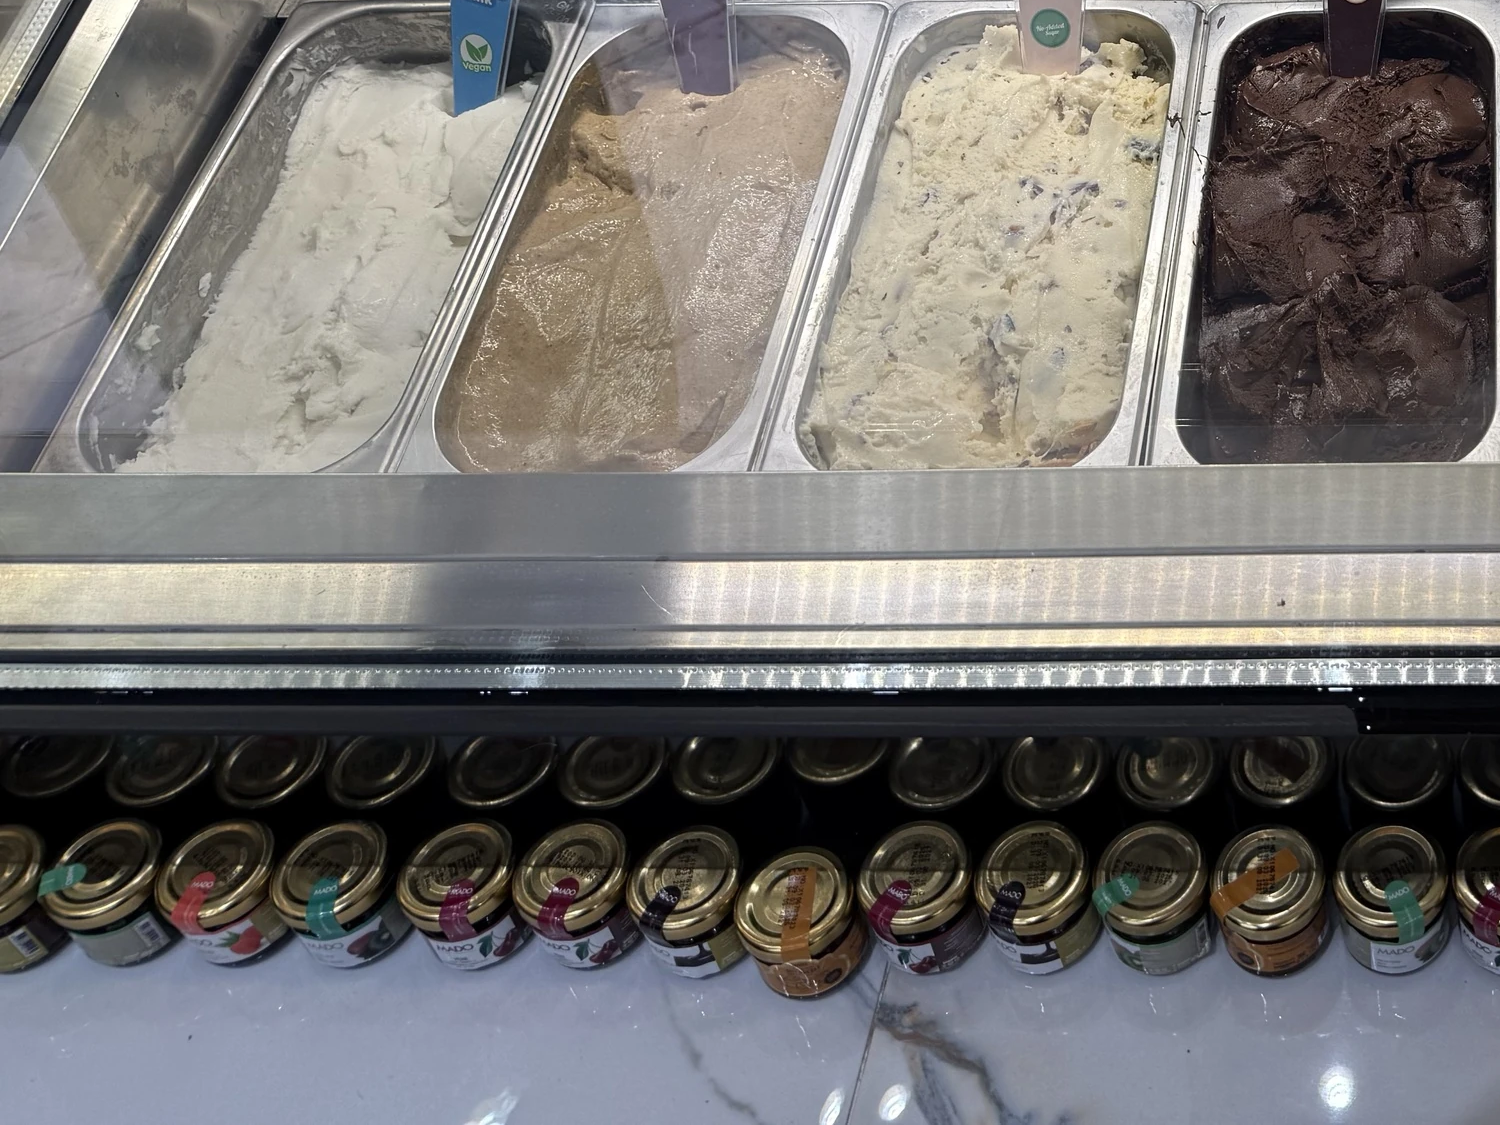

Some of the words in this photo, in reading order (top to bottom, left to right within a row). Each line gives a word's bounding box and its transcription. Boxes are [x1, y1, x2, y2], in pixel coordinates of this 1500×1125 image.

[462, 61, 492, 73] Vegan
[191, 880, 214, 890] MADO
[314, 884, 337, 896] MADO
[1117, 877, 1132, 897] MADO
[1388, 886, 1410, 901] MADO
[1463, 928, 1492, 954] MADO
[436, 942, 474, 953] MADO
[1377, 945, 1415, 956] MADO
